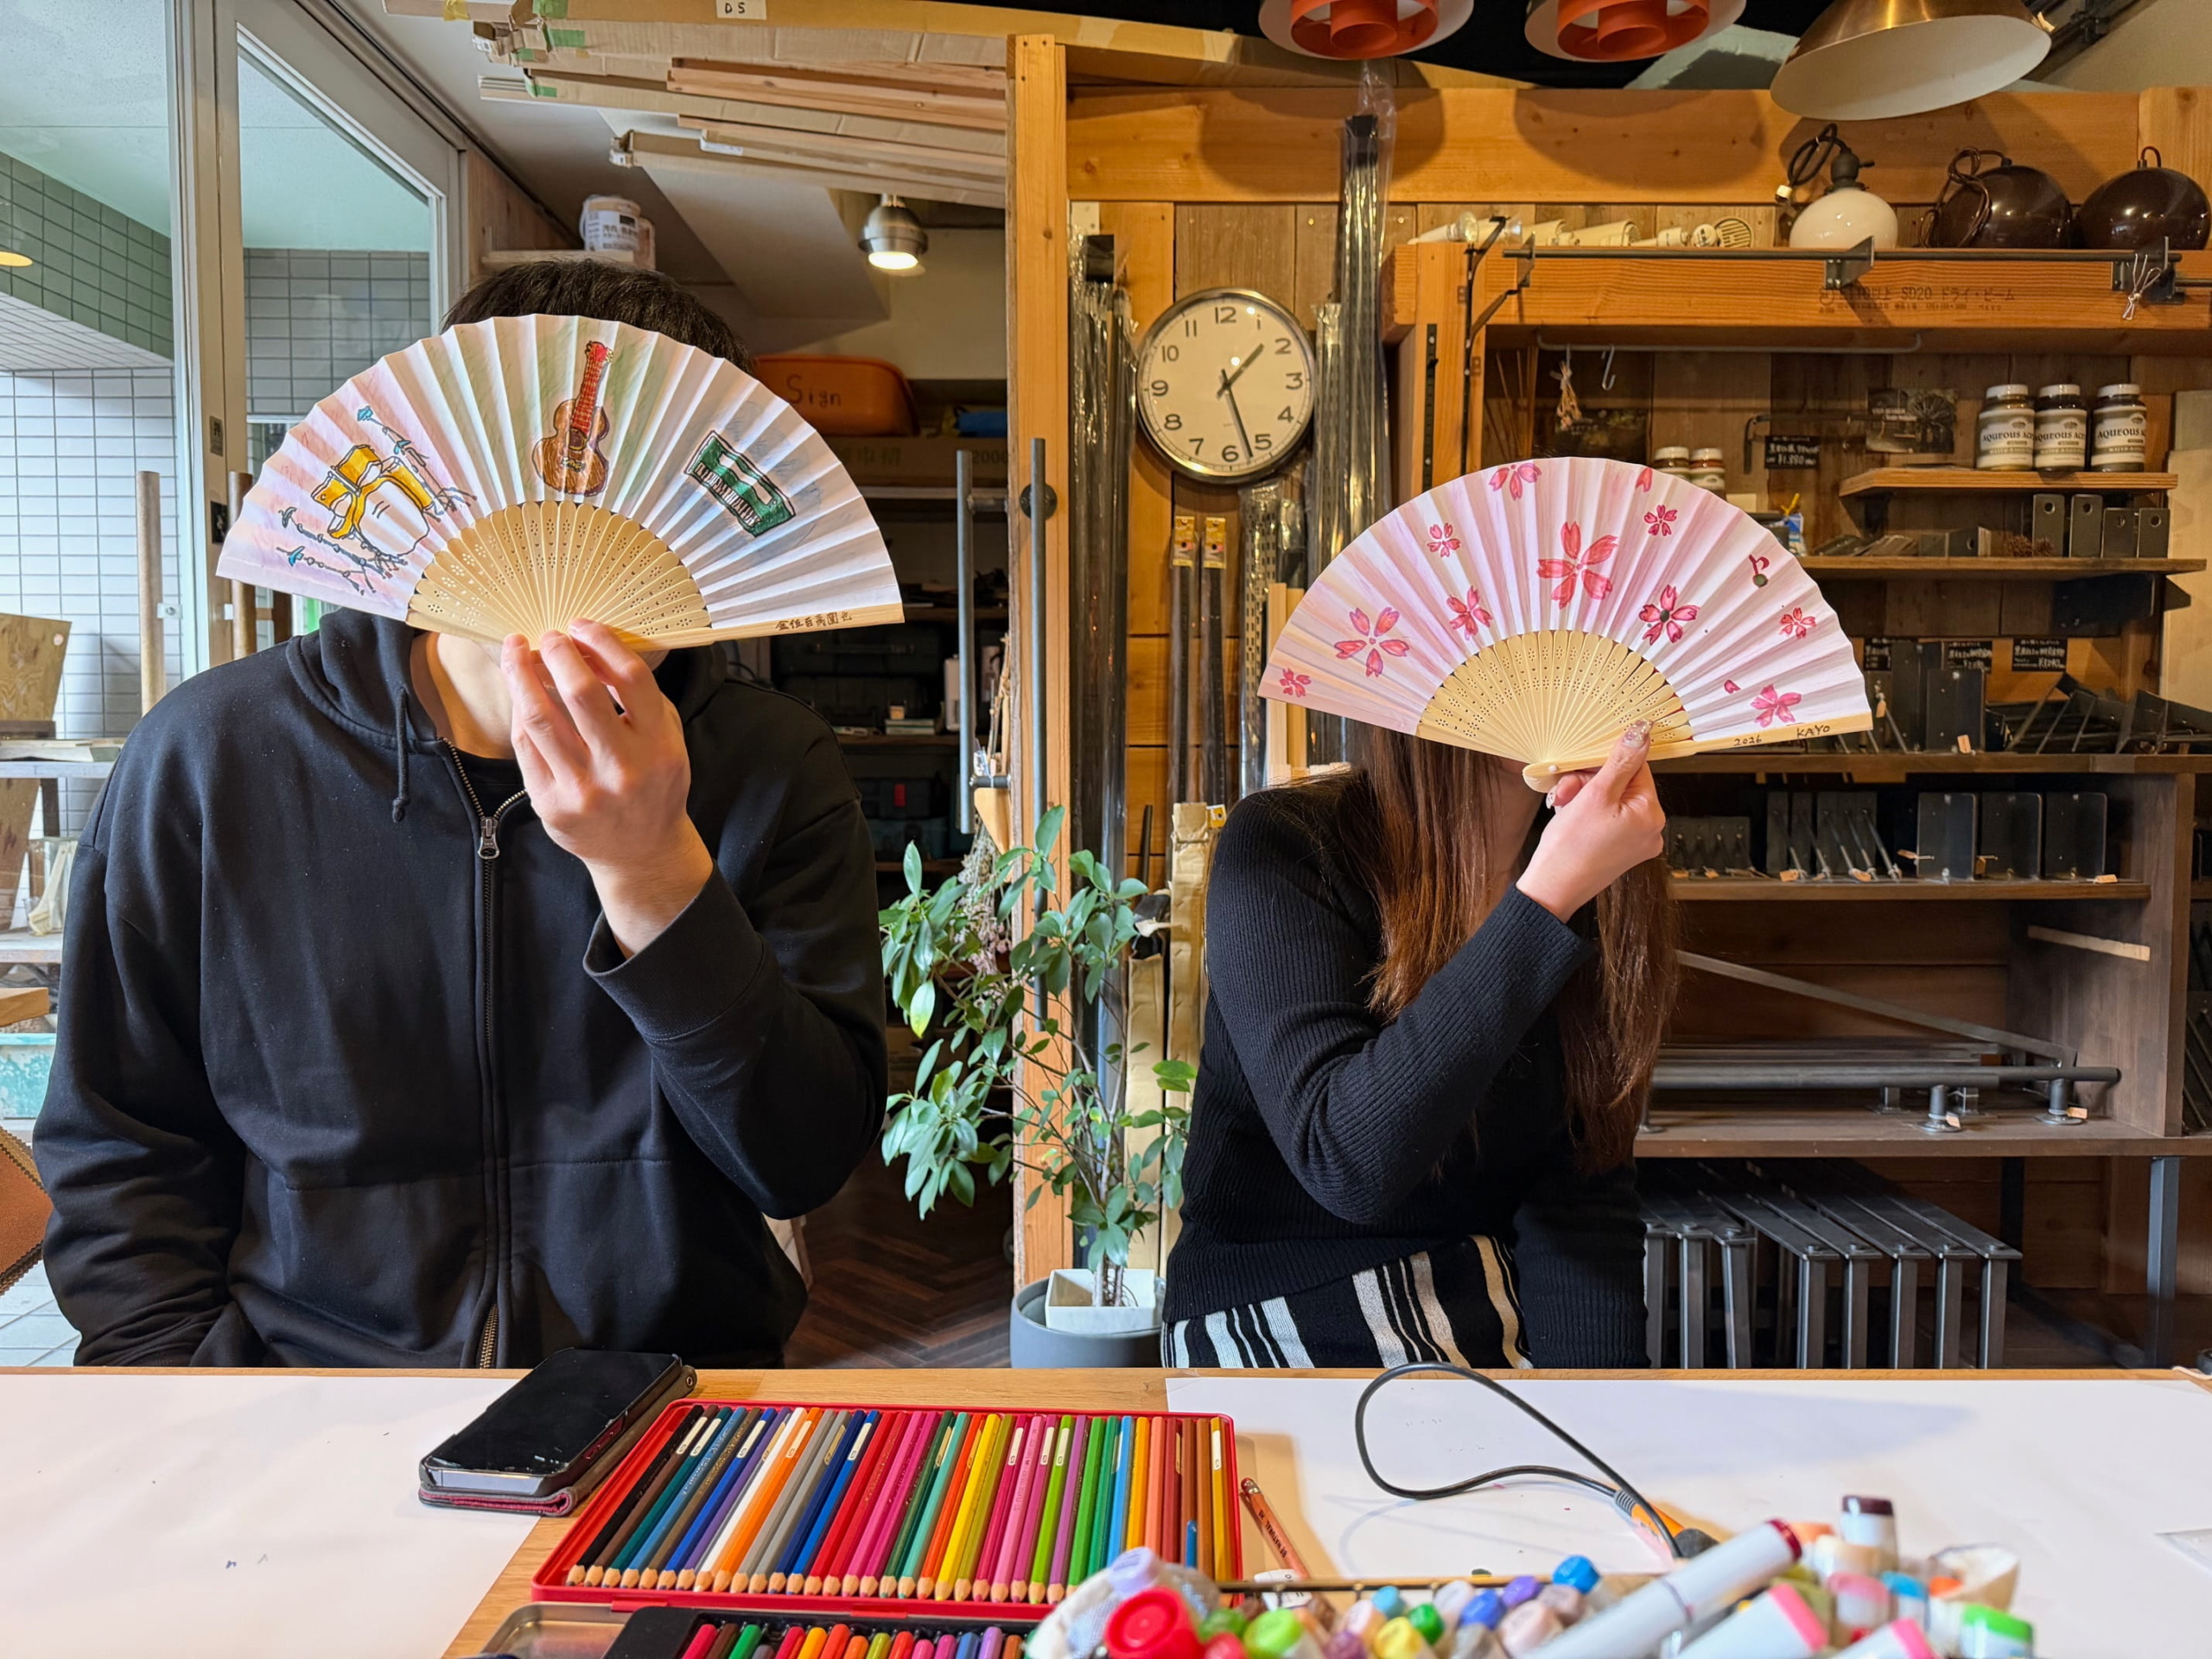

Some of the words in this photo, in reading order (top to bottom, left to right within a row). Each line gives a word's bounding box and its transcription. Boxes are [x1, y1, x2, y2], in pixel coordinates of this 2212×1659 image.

[1215, 307, 1236, 324] 12
[1185, 320, 1198, 337] 11
[1161, 345, 1179, 362] 10
[1274, 338, 1292, 355] 2
[1151, 380, 1168, 397] 9
[1286, 372, 1303, 390] 3
[786, 374, 842, 408] Sign
[1164, 414, 1182, 430] 8
[1277, 406, 1294, 423] 4
[1255, 434, 1272, 450] 5
[1982, 431, 2021, 442] AQUEOUS
[2033, 431, 2072, 442] AQUEOUS
[2097, 428, 2139, 439] AQUEOUS
[1189, 438, 1205, 455] 7
[1222, 446, 1239, 462] 6
[1733, 734, 1762, 746] 2026
[1796, 725, 1831, 739] KAYO
[1265, 1520, 1282, 1549] NATURAL
